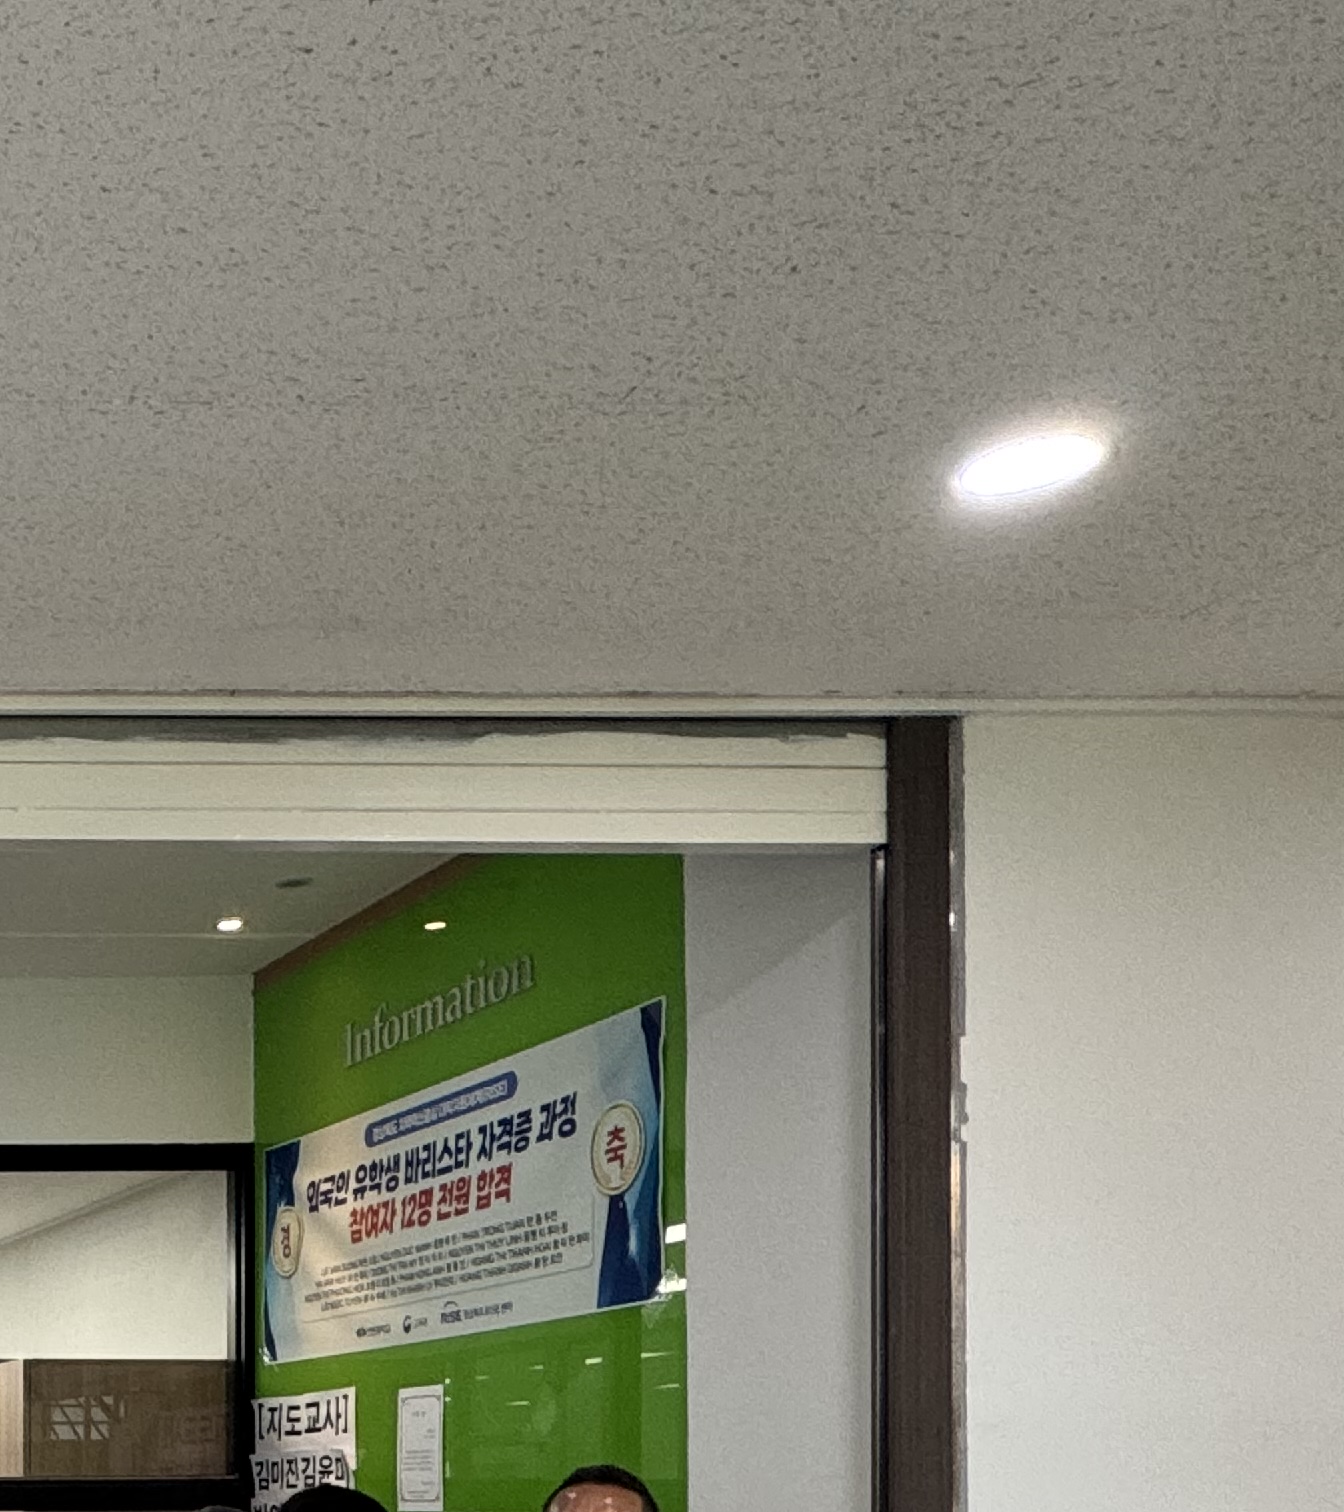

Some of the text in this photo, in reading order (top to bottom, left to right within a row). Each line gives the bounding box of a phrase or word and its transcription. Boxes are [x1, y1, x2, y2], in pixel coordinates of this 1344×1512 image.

[346, 951, 536, 1069] Information
[307, 1169, 352, 1214] 외국인
[353, 1152, 401, 1201] 유학생
[404, 1129, 473, 1185] 바리스타
[477, 1107, 532, 1161] 자격증
[535, 1091, 577, 1144] 과정
[605, 1125, 625, 1170] 축
[349, 1162, 512, 1244] 참여자 12명 전원 합격
[258, 1393, 349, 1441] [지도교사]
